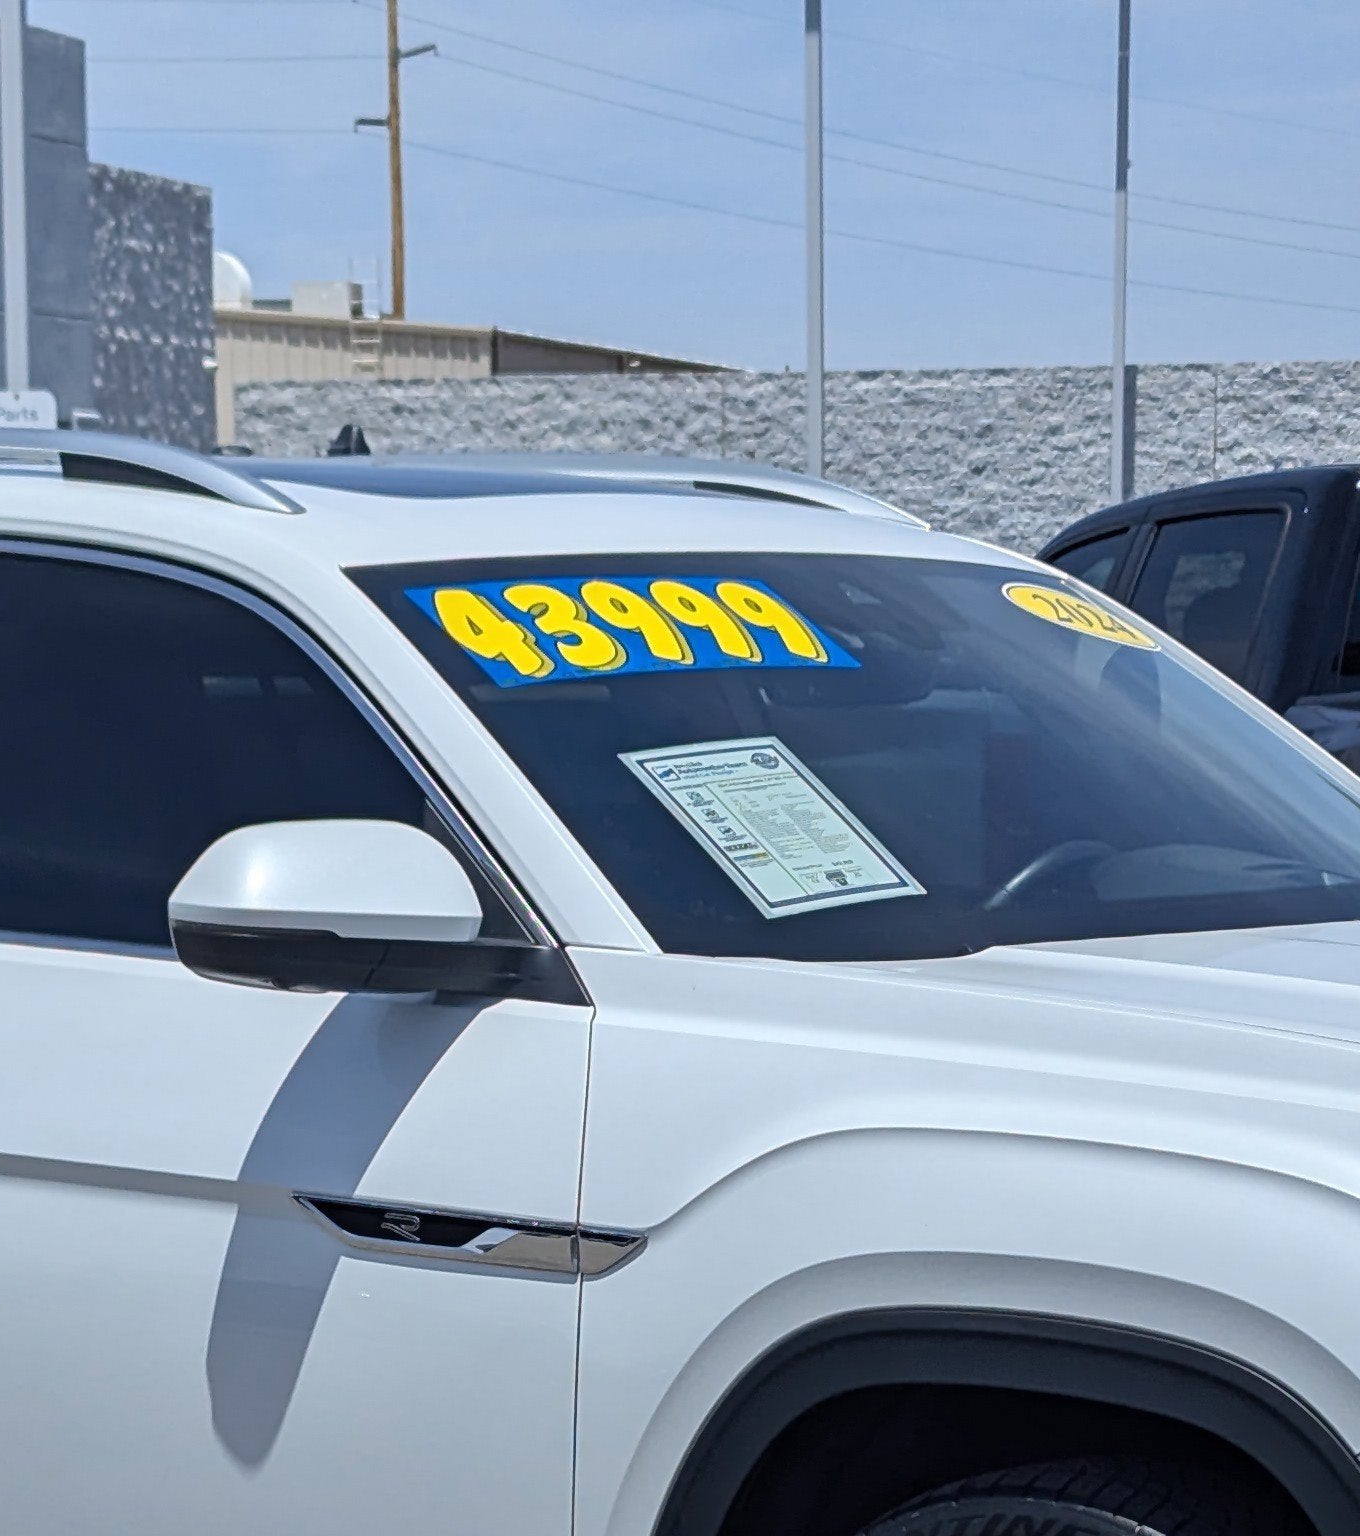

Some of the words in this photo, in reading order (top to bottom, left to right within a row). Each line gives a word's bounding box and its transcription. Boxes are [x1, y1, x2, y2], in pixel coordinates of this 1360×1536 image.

[433, 579, 829, 678] 43999
[1031, 592, 1138, 640] 2024
[380, 1212, 421, 1241] R
